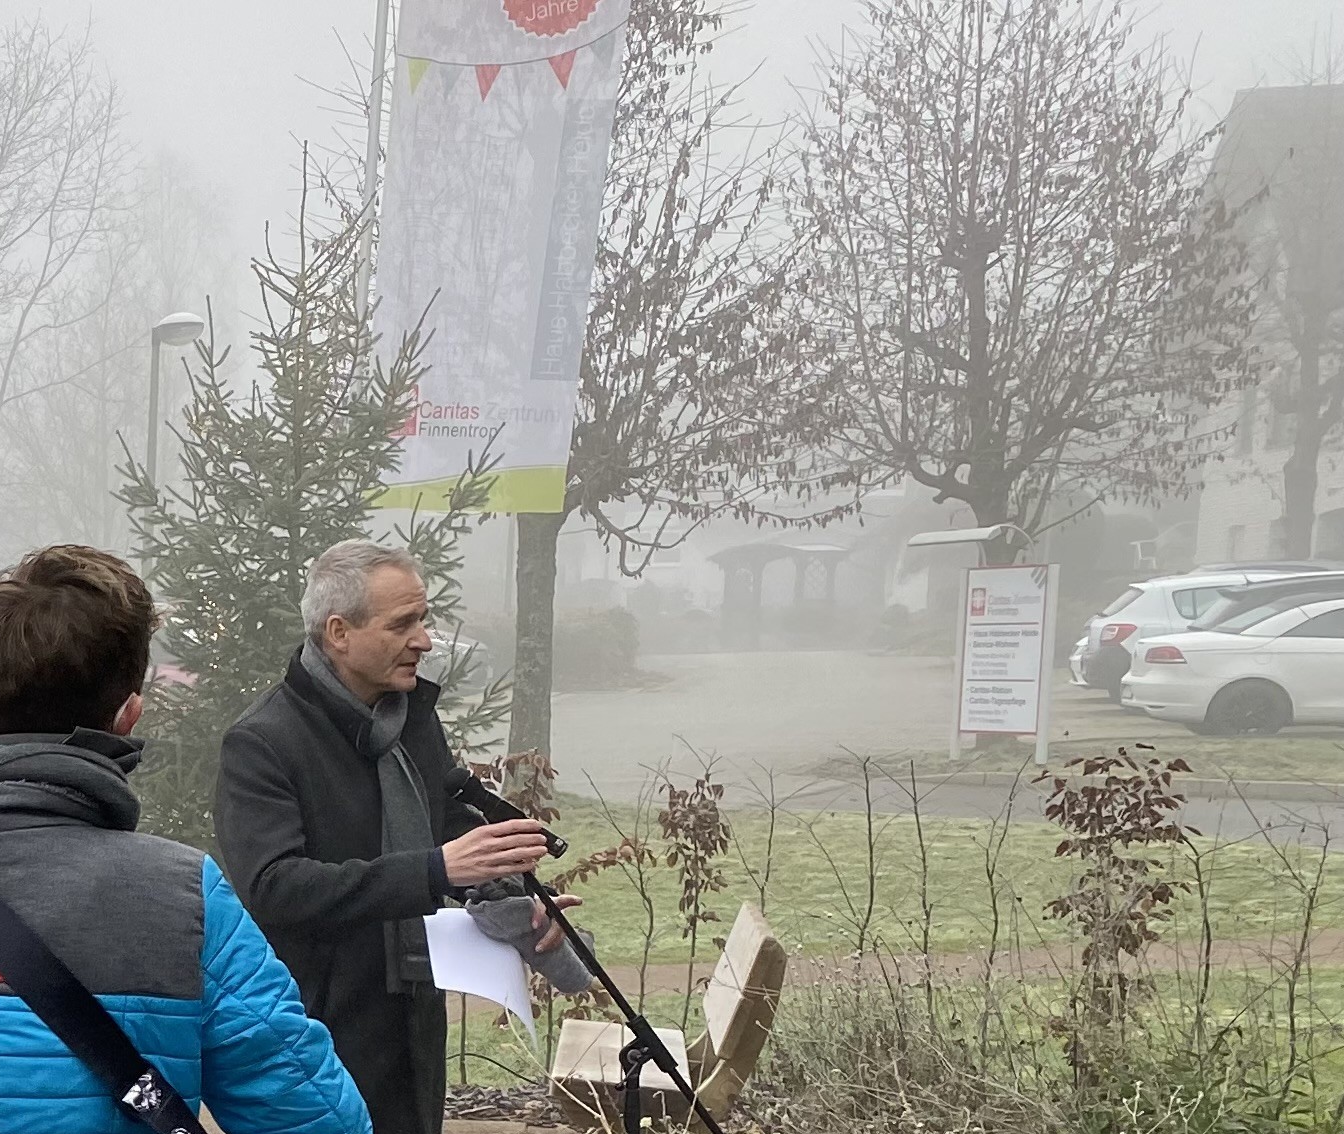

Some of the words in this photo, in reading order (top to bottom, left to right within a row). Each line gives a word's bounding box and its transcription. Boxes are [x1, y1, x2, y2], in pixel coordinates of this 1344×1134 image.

[525, 0, 579, 21] Jahre
[540, 316, 568, 376] Haus
[420, 400, 480, 420] Caritas
[484, 402, 561, 424] Zentrum
[418, 422, 499, 442] Finnentrop
